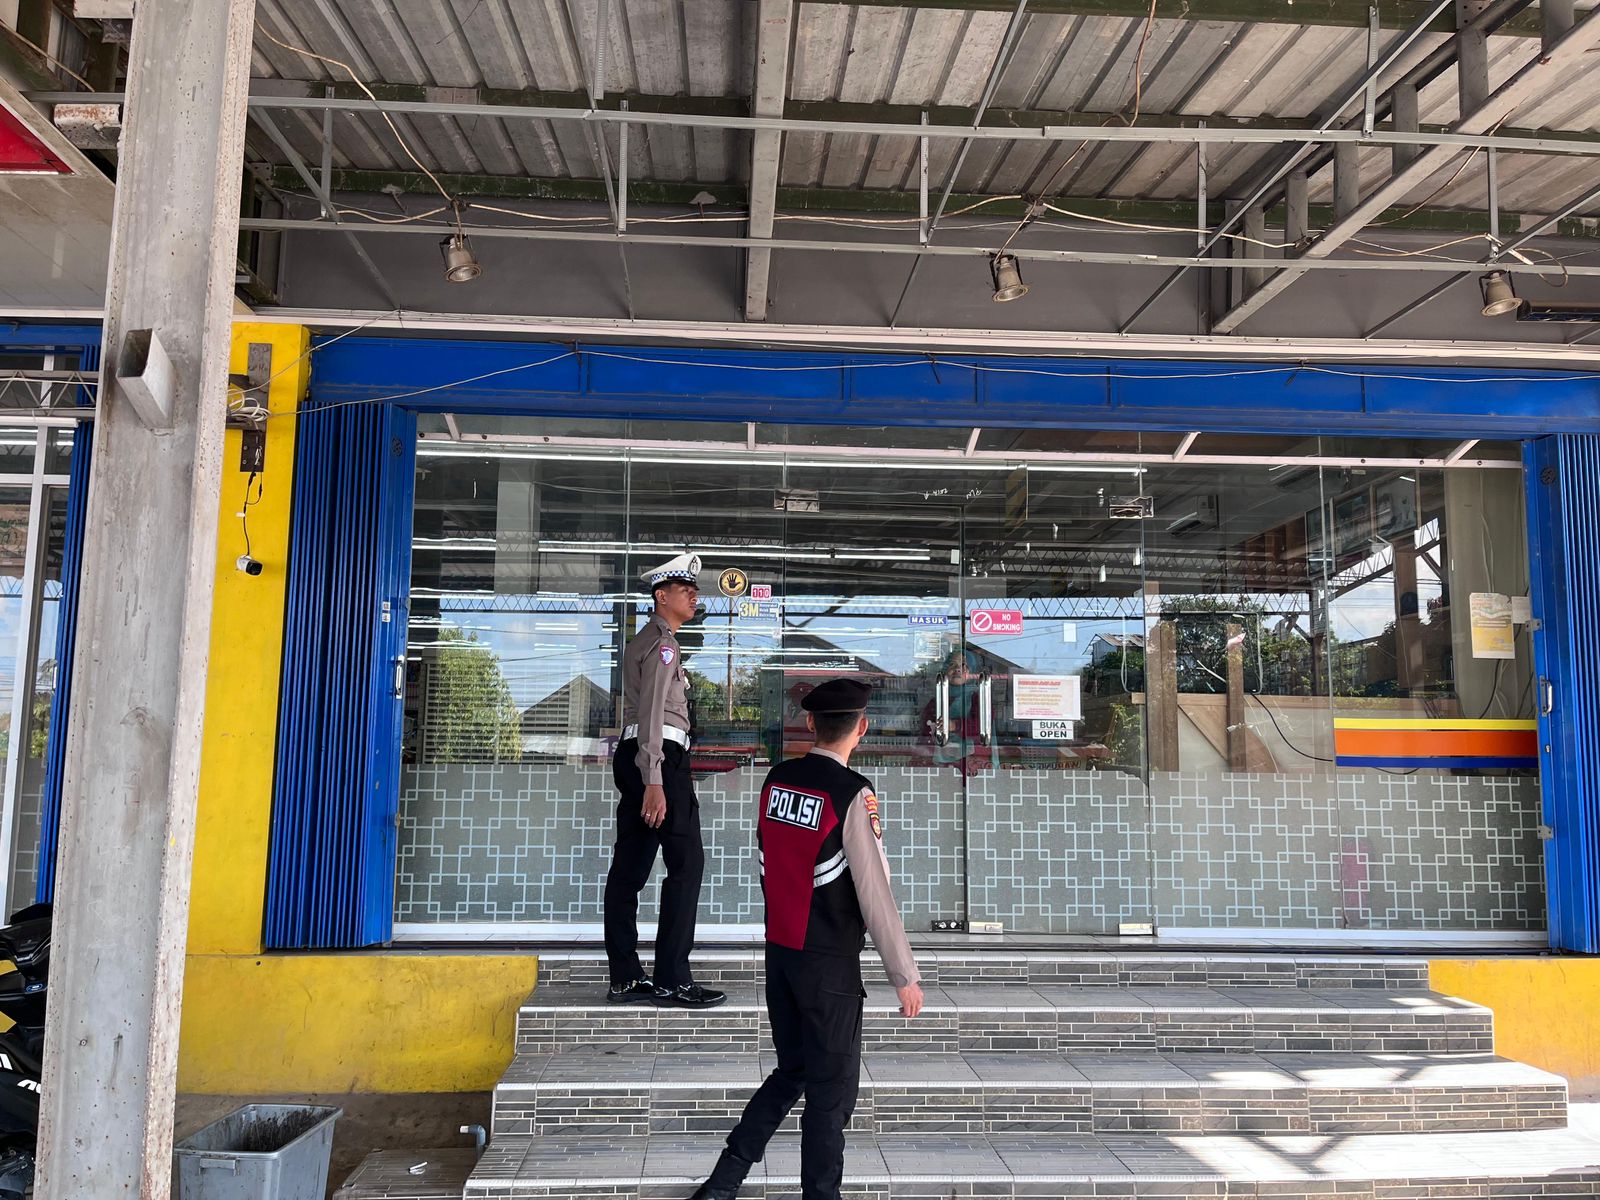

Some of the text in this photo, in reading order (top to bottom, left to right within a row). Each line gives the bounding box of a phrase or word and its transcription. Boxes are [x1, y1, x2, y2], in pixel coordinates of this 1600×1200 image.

[752, 588, 771, 598] 110
[741, 602, 759, 617] 3M
[911, 616, 945, 624] MASUK
[1001, 613, 1011, 621] NO
[992, 623, 1021, 631] SMOKING
[1039, 721, 1067, 729] BUKA
[1039, 730, 1067, 738] OPEN
[768, 789, 821, 827] POLISI
